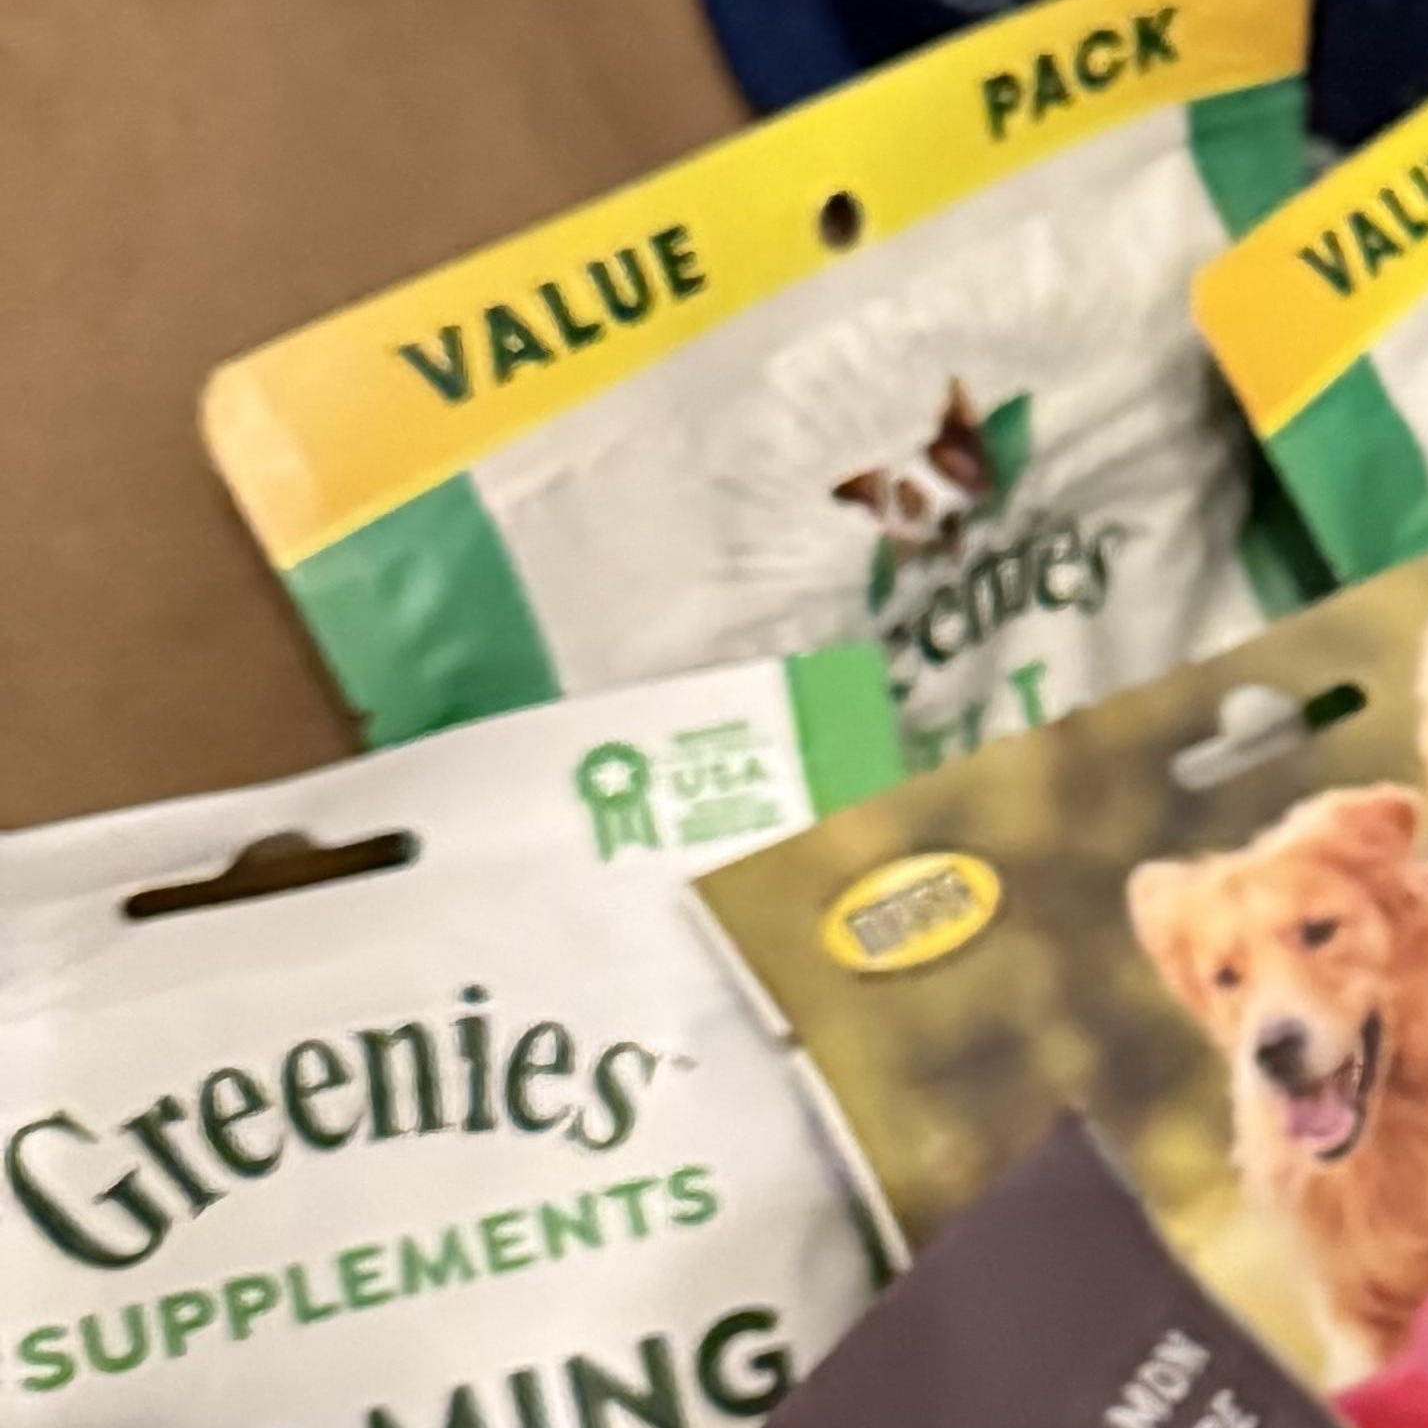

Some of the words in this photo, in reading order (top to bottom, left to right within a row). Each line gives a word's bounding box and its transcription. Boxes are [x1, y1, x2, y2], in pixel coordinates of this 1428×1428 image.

[400, 224, 709, 407] VALUE
[979, 6, 1182, 144] PACK
[2, 984, 660, 1270] Greenies
[15, 1164, 722, 1394] SUPPLEMENTS
